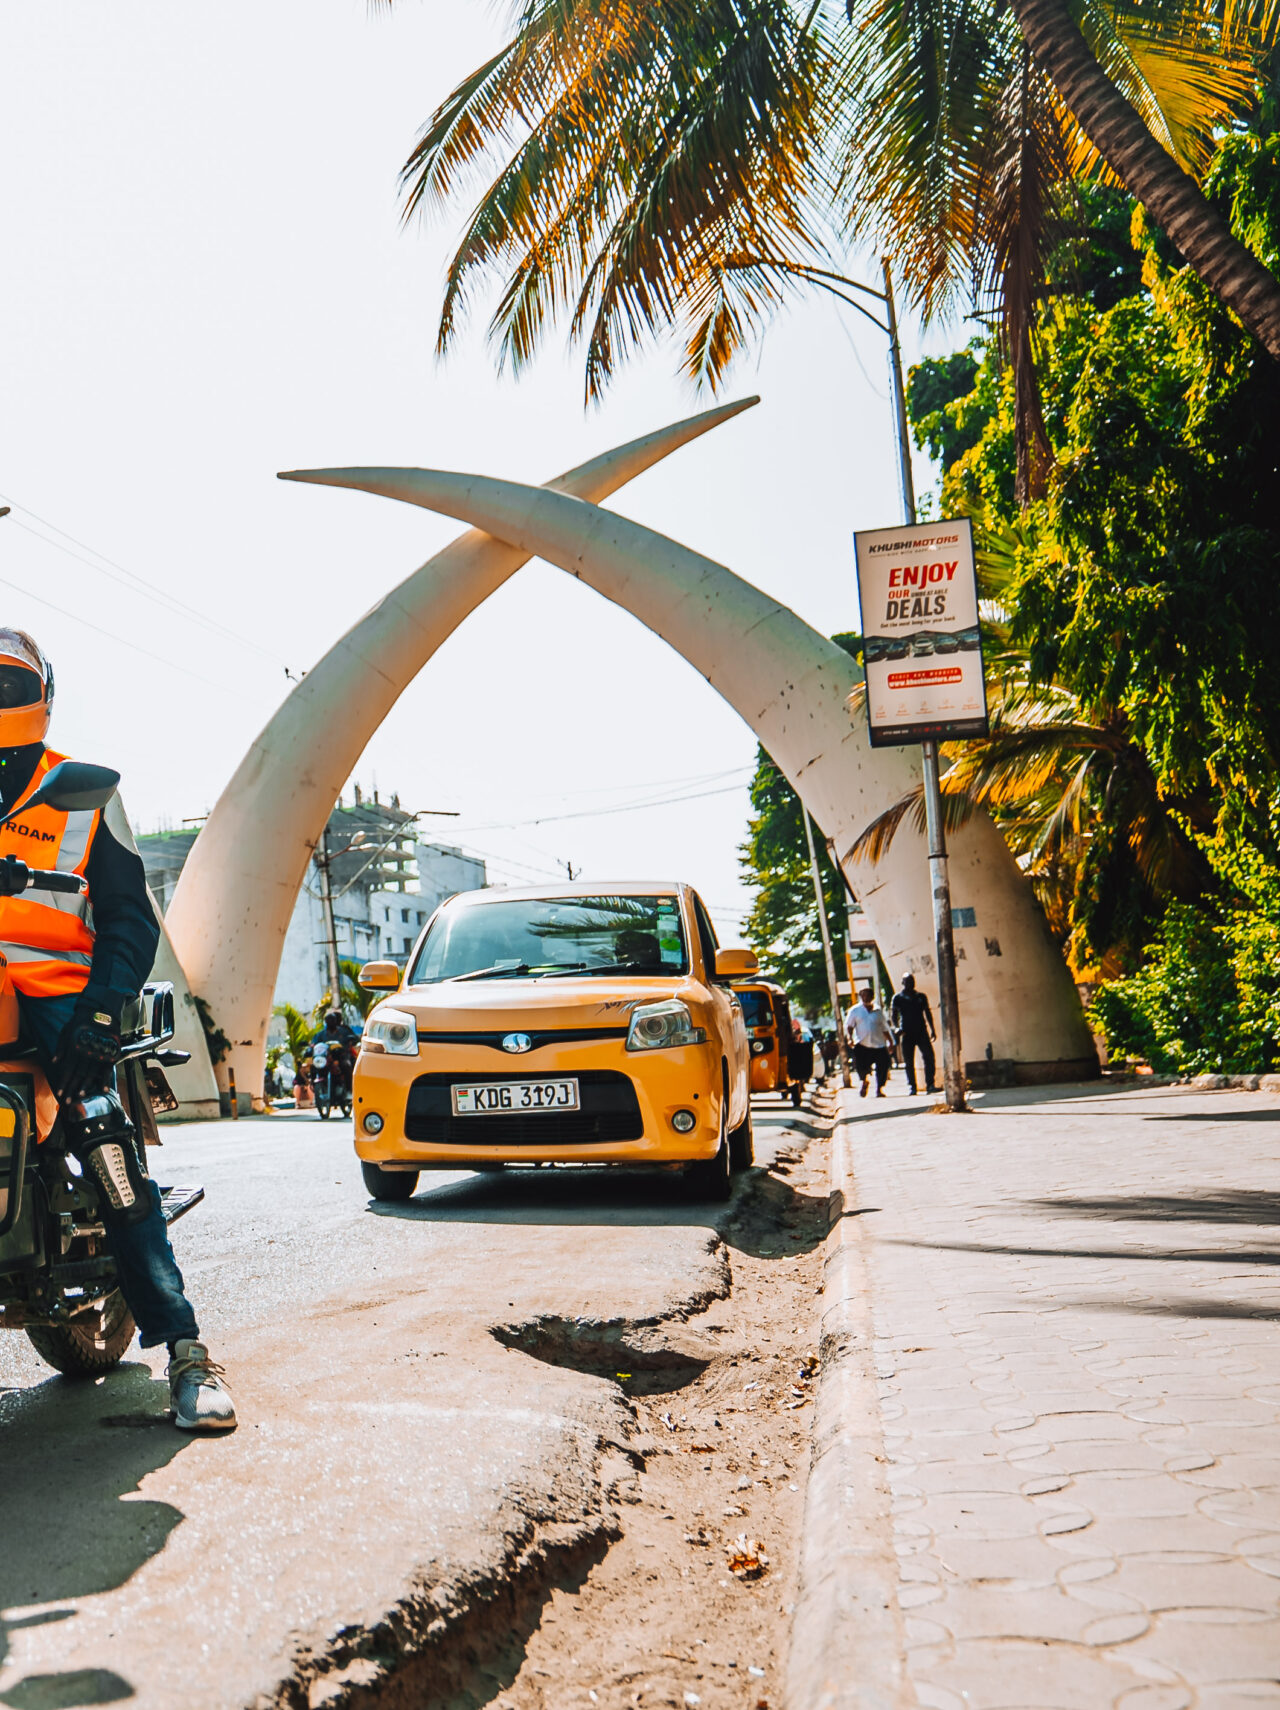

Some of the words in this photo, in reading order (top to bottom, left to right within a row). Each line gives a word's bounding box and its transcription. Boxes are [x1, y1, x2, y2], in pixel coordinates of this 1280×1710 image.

[888, 560, 959, 590] ENJOY
[888, 589, 910, 600] OUR
[886, 595, 946, 621] DEALS
[6, 821, 56, 843] ROAM
[473, 1088, 512, 1109] KDG
[520, 1084, 570, 1107] 319J
